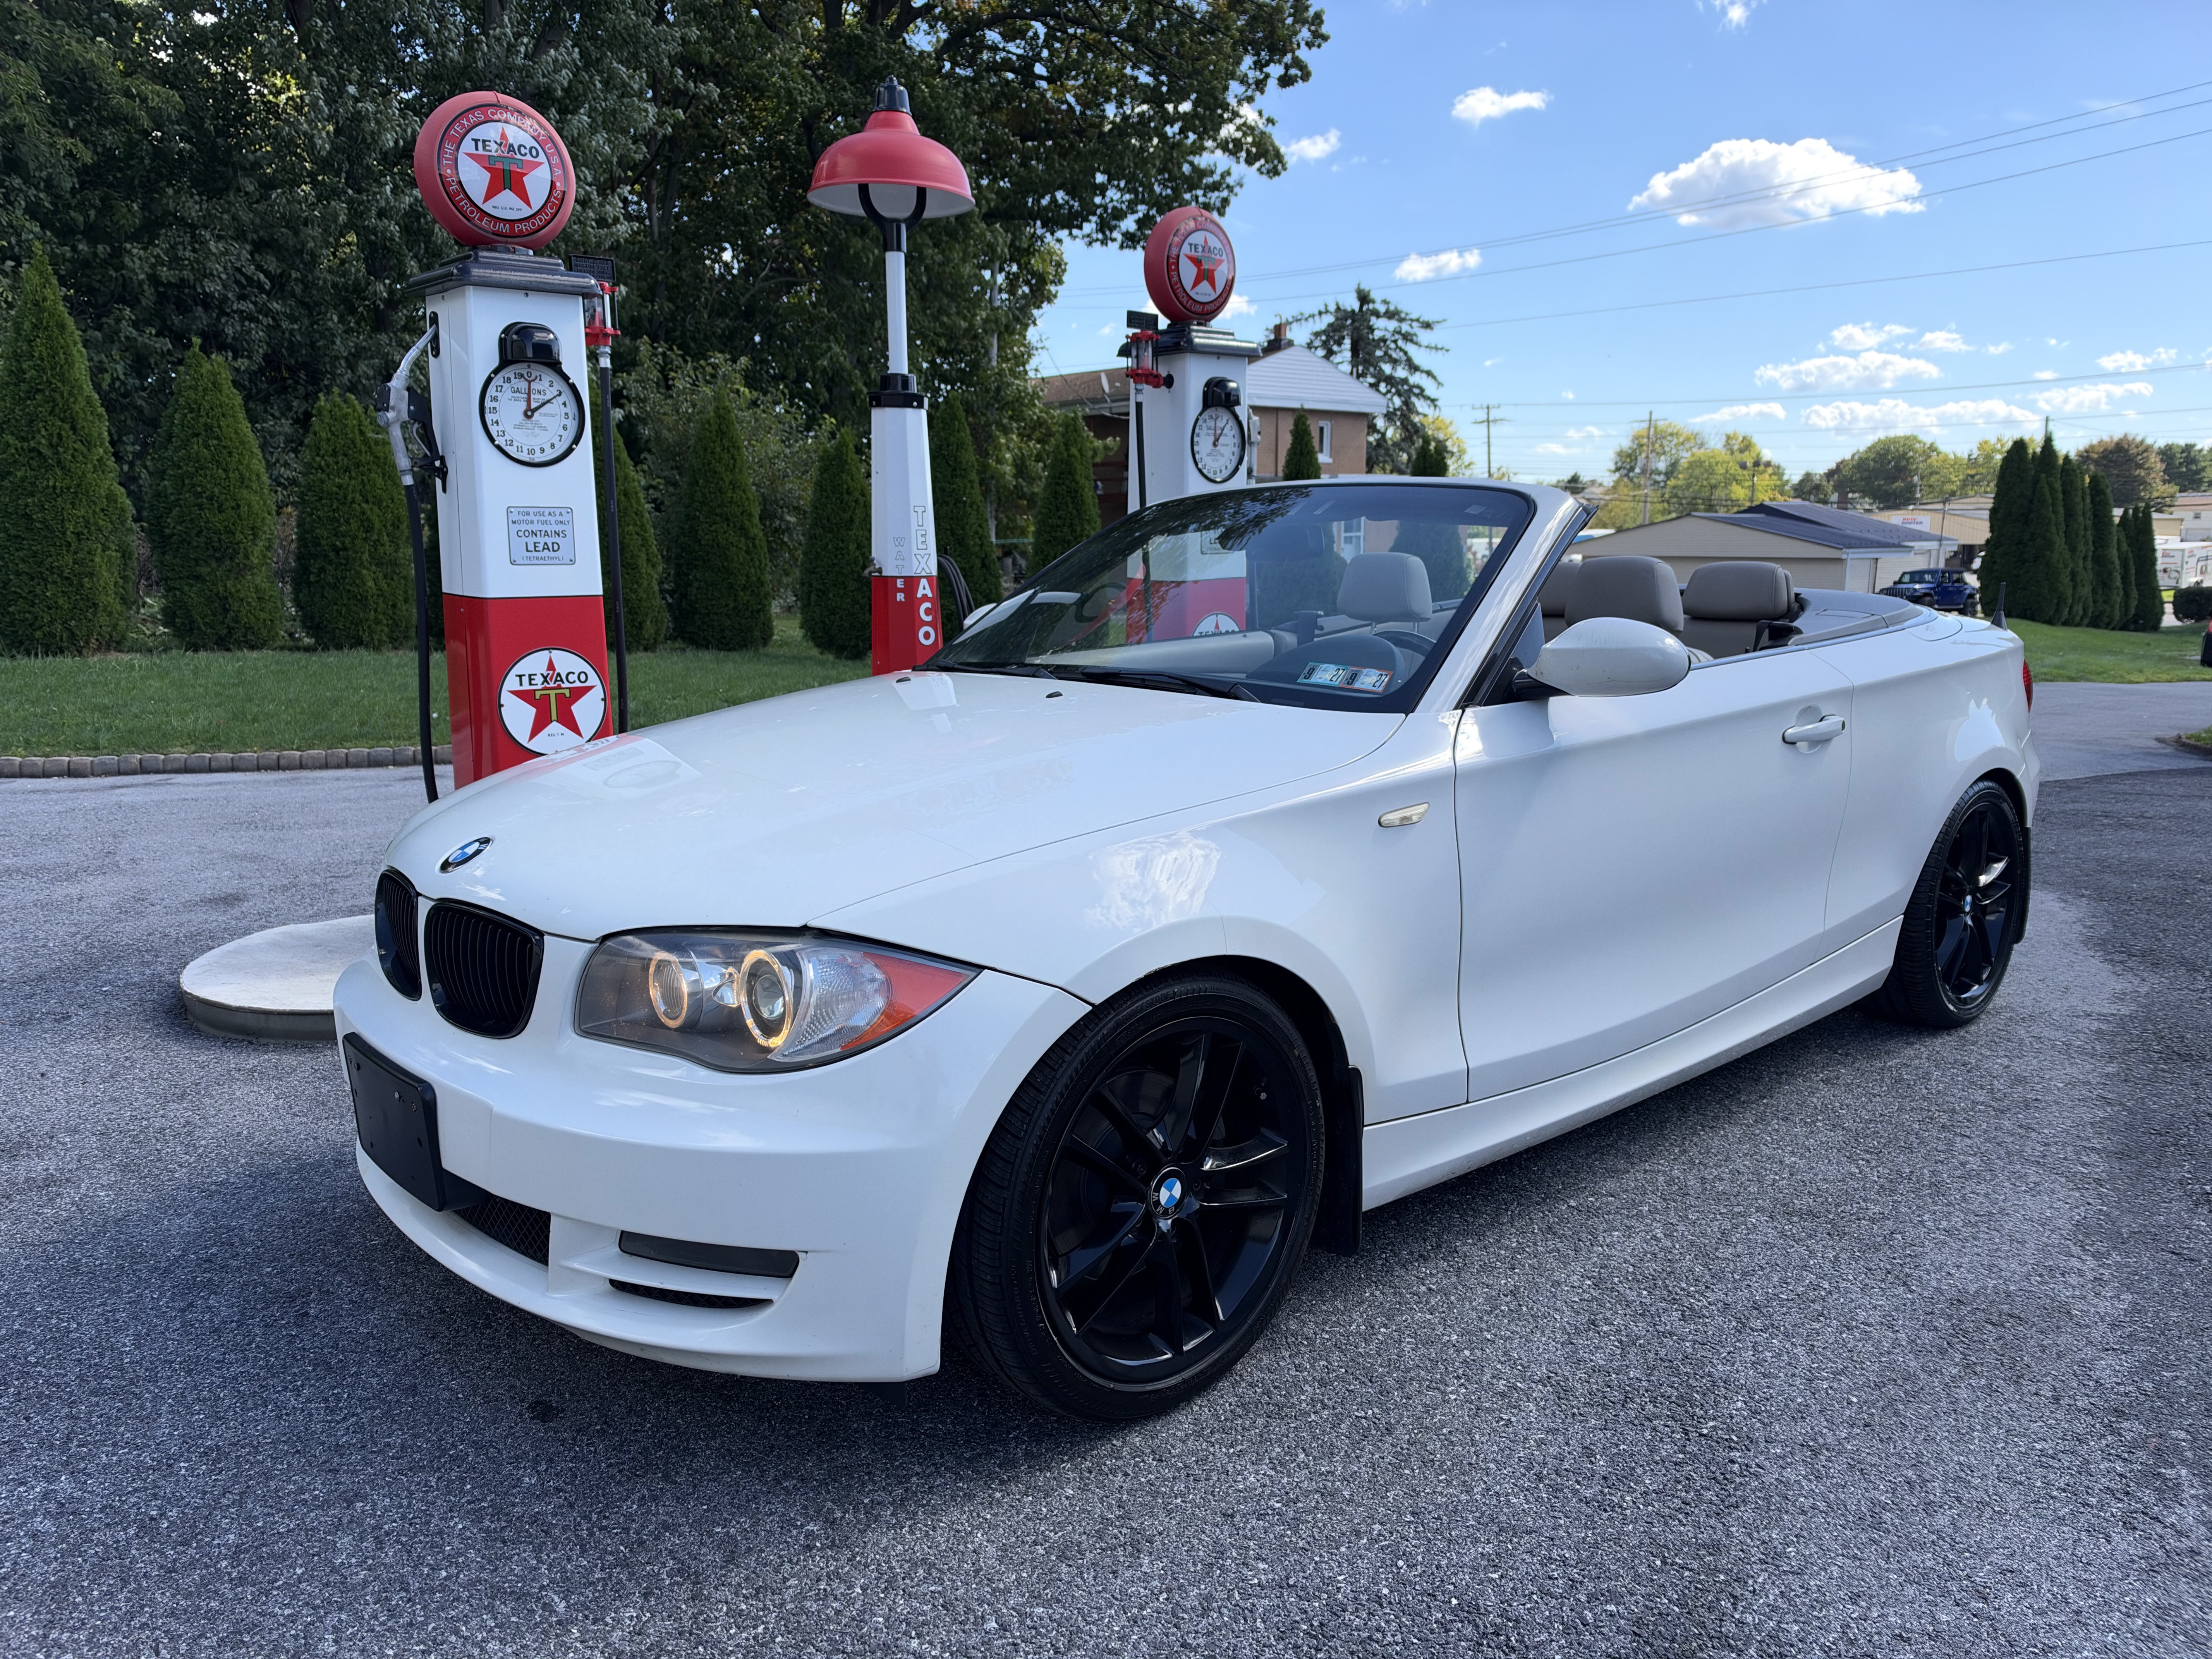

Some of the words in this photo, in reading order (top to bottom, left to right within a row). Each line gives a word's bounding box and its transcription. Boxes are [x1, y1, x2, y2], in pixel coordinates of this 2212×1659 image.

[443, 141, 455, 167] THE
[449, 110, 484, 137] TEXAS
[487, 109, 546, 141] COMPANY
[471, 138, 540, 158] TEXACO
[488, 155, 524, 191] T
[446, 177, 510, 233] PETROLEUM
[515, 189, 561, 233] PRODUCTS
[1170, 245, 1179, 263] THE
[1188, 243, 1223, 257] TEXACO
[1197, 256, 1216, 281] T
[1171, 272, 1202, 312] PETROLEUM
[511, 386, 546, 396] GALLONS
[516, 529, 567, 538] CONTAINS
[525, 541, 560, 552] LEAD
[893, 537, 905, 602] WATER
[914, 505, 936, 646] TEXACO
[515, 671, 589, 687] TEXACO
[1304, 667, 1316, 680] 9
[1329, 668, 1346, 684] 27
[1346, 673, 1358, 685] 9
[1372, 673, 1389, 689] 27
[533, 687, 572, 723] T
[1114, 990, 1171, 1030] BRIDGESTONE
[1152, 1192, 1175, 1214] BMW
